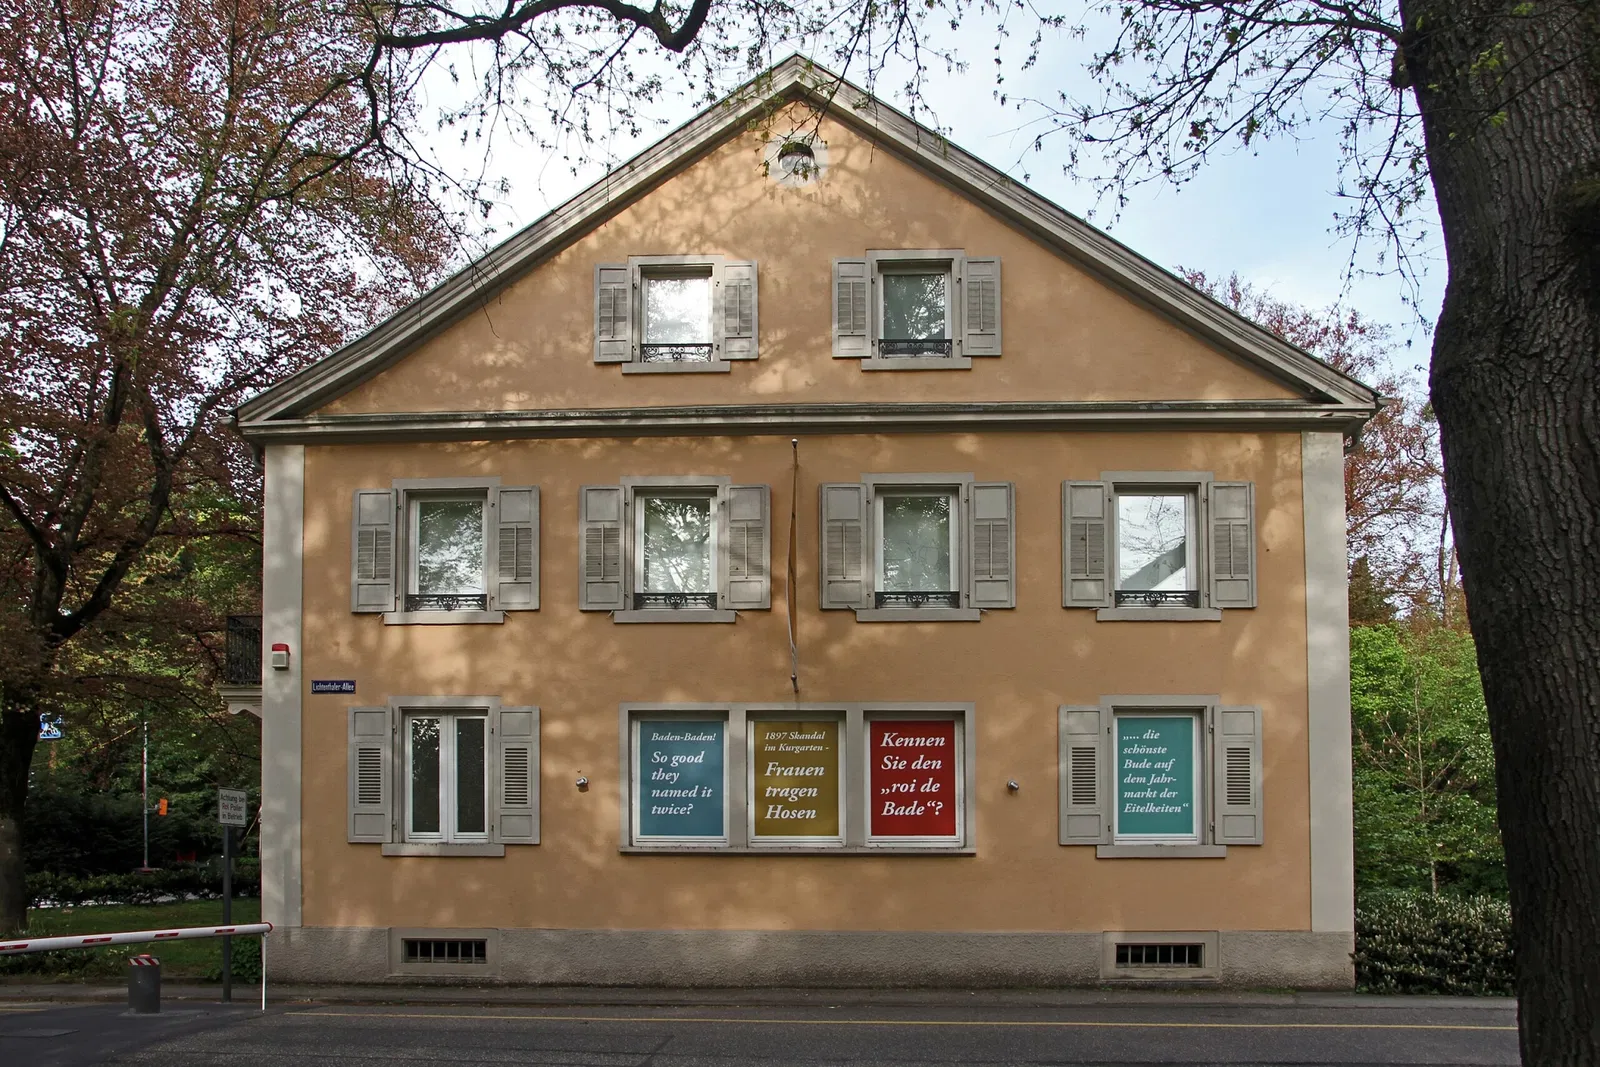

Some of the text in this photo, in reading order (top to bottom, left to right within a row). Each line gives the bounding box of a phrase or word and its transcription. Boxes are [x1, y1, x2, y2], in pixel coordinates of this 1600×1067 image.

[652, 732, 716, 741] Baden-Baden!
[765, 731, 825, 740] 1897 Skandal
[880, 733, 945, 747] Kennen
[1143, 729, 1160, 739] die
[779, 744, 823, 753] Kurgarten
[1123, 744, 1167, 754] schönste
[652, 751, 705, 767] So good
[881, 755, 942, 770] Sie den
[1124, 759, 1175, 771] Bude auf
[765, 762, 824, 776] Frauen
[652, 768, 679, 784] they
[1124, 774, 1177, 785] dem Jahr-
[652, 785, 712, 797] named it
[920, 778, 940, 792] de
[765, 786, 818, 802] tragen
[1124, 788, 1178, 798] markt der
[652, 804, 693, 814] twice?
[765, 805, 816, 819] Hosen
